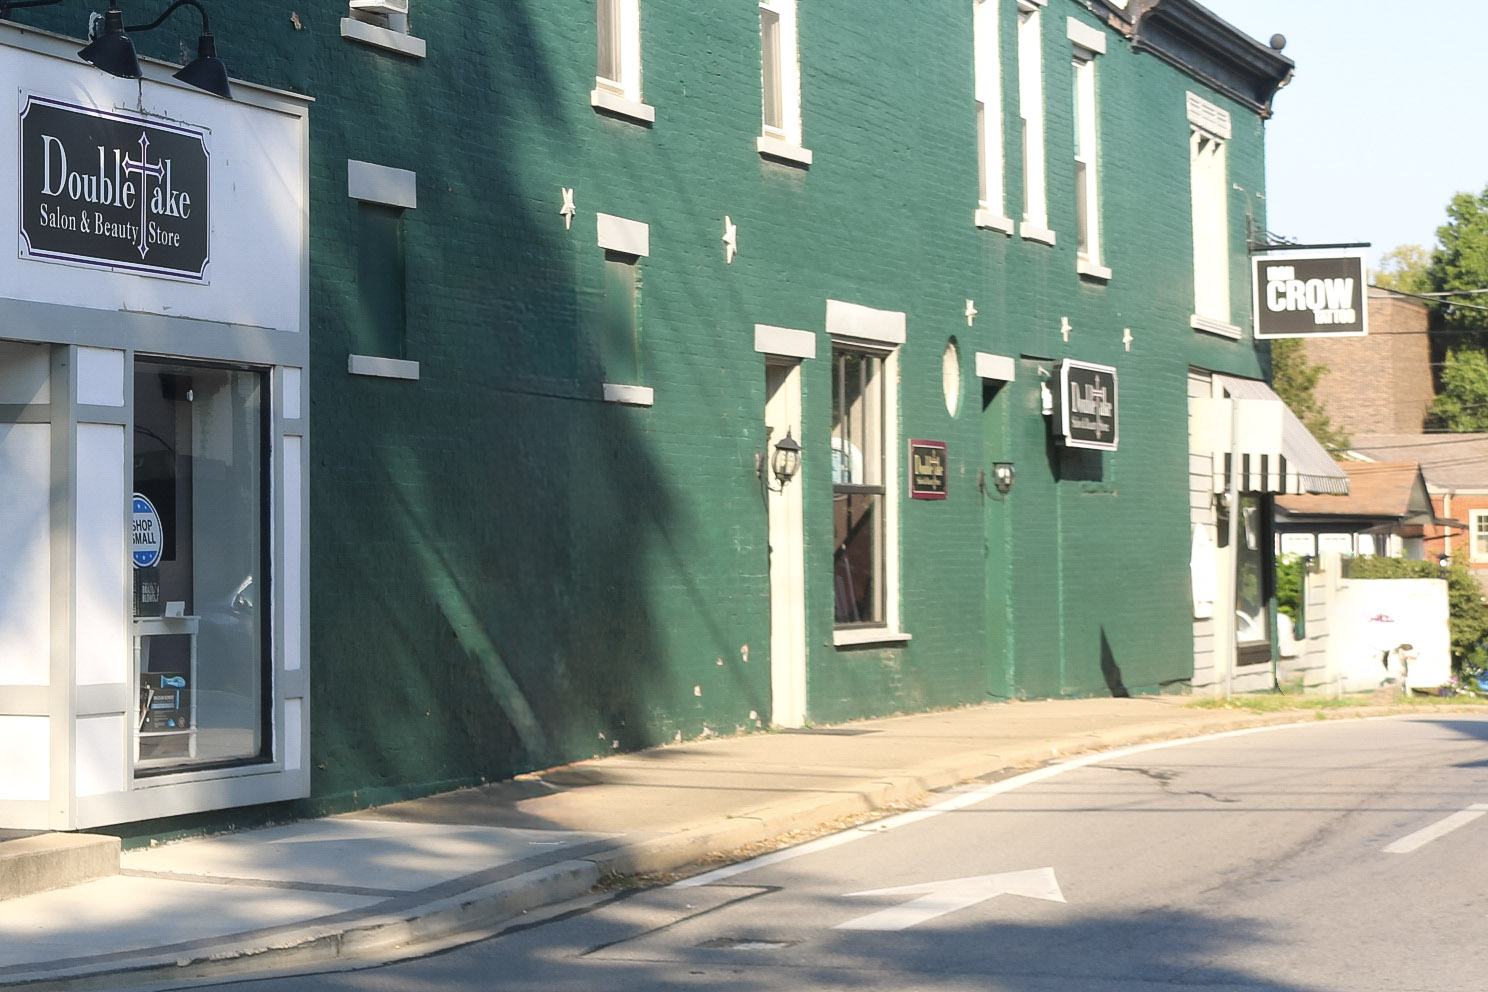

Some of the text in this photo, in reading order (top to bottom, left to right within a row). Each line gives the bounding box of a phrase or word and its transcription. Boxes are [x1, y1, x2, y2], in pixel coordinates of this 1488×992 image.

[41, 134, 136, 209] Double
[40, 204, 180, 247] Salon & Beauty Store
[1266, 278, 1354, 312] CROW
